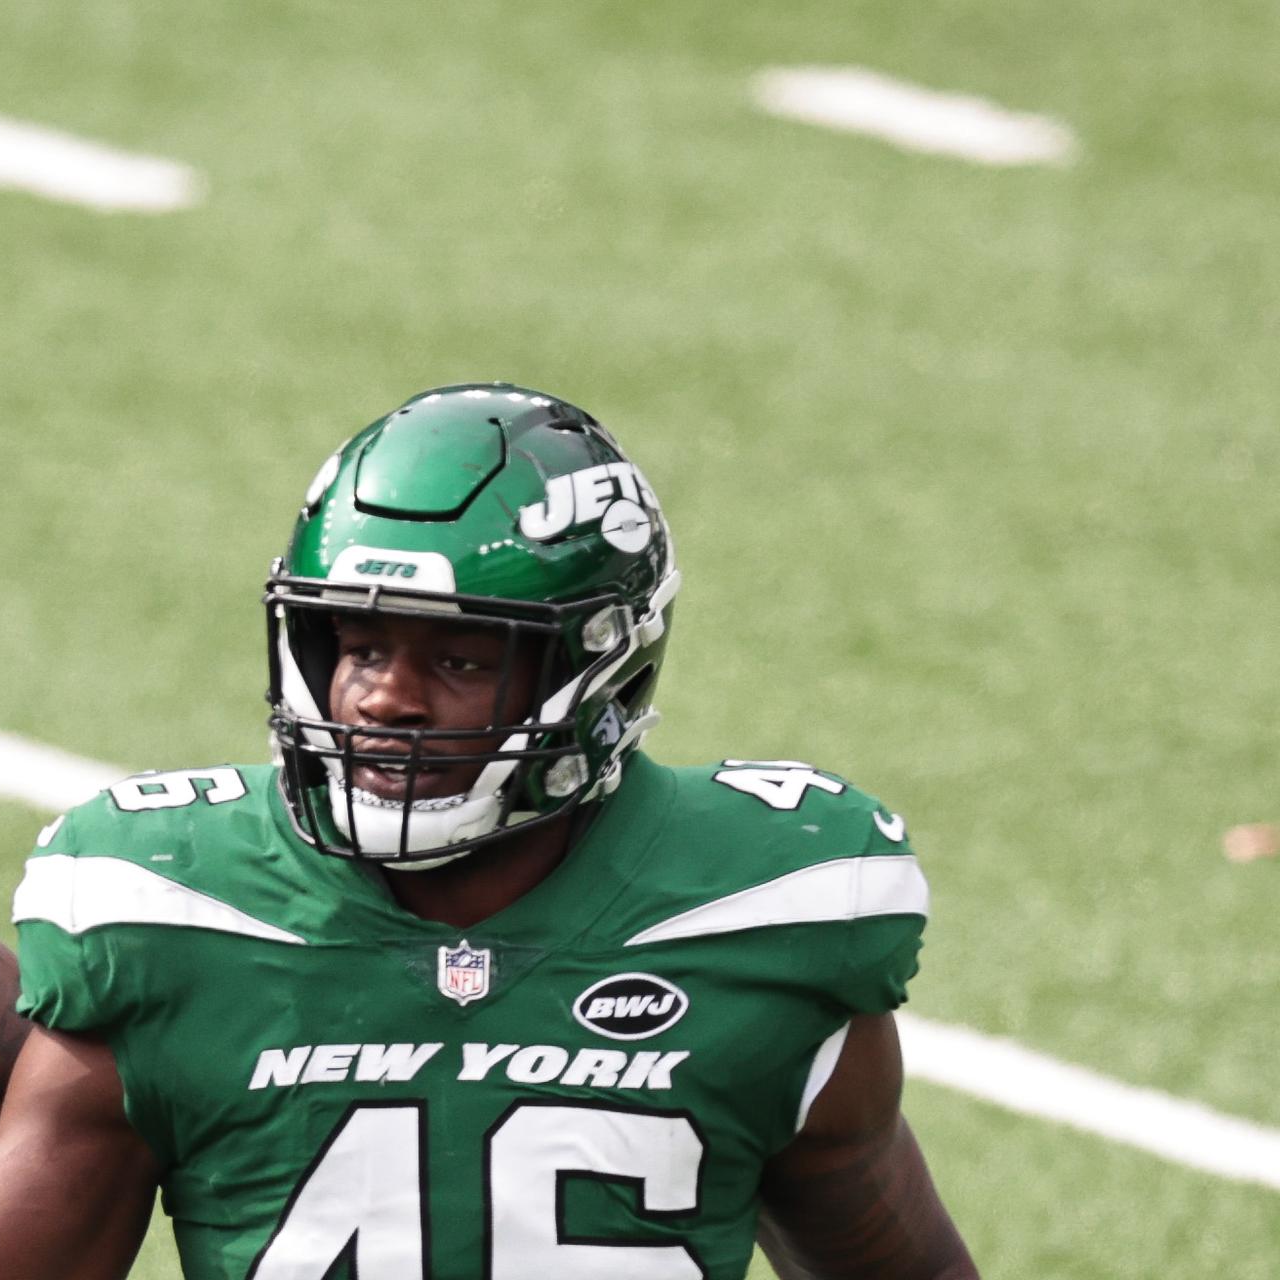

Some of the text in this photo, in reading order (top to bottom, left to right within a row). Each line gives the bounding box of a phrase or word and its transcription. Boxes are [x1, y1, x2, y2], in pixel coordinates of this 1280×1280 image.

[355, 559, 418, 578] JETS
[102, 763, 250, 813] 6
[710, 759, 848, 812] 4
[446, 967, 483, 993] NFL
[585, 993, 677, 1019] BWJ
[248, 1042, 690, 1090] NEW YORK
